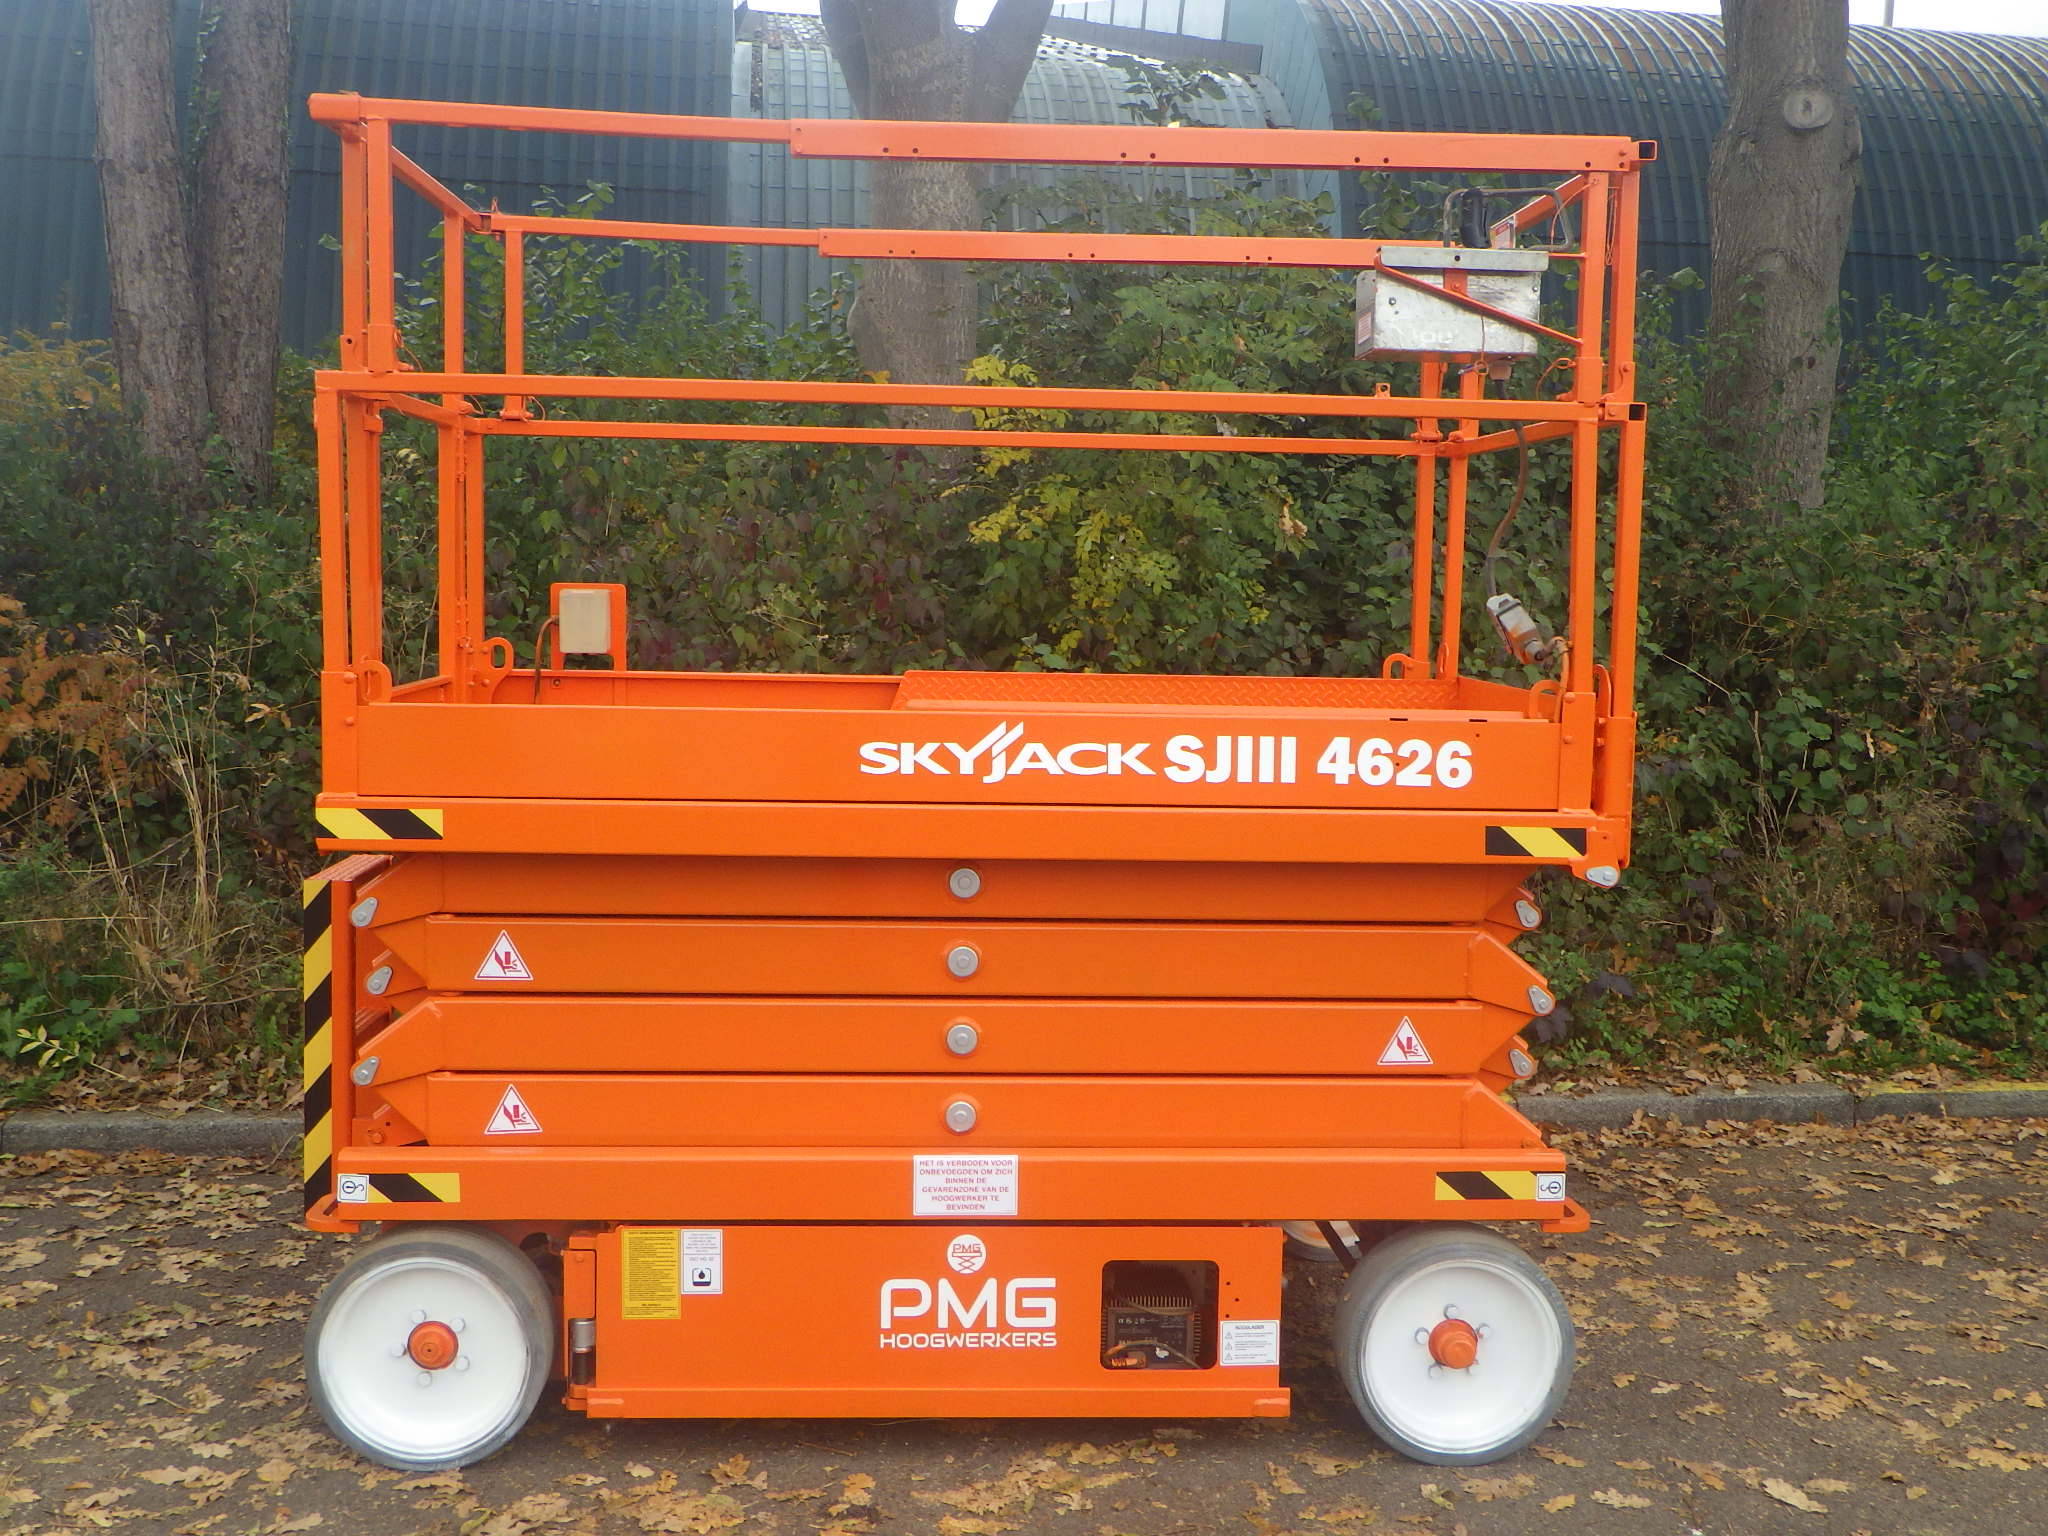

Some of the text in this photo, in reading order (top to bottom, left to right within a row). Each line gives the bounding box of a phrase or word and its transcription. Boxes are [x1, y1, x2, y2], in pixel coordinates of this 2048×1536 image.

[859, 720, 1473, 788] SKYJACK SJIII 4626
[952, 1243, 982, 1253] PMG
[880, 1277, 1057, 1329] PMG
[879, 1332, 1057, 1349] HOOGWERKERS
